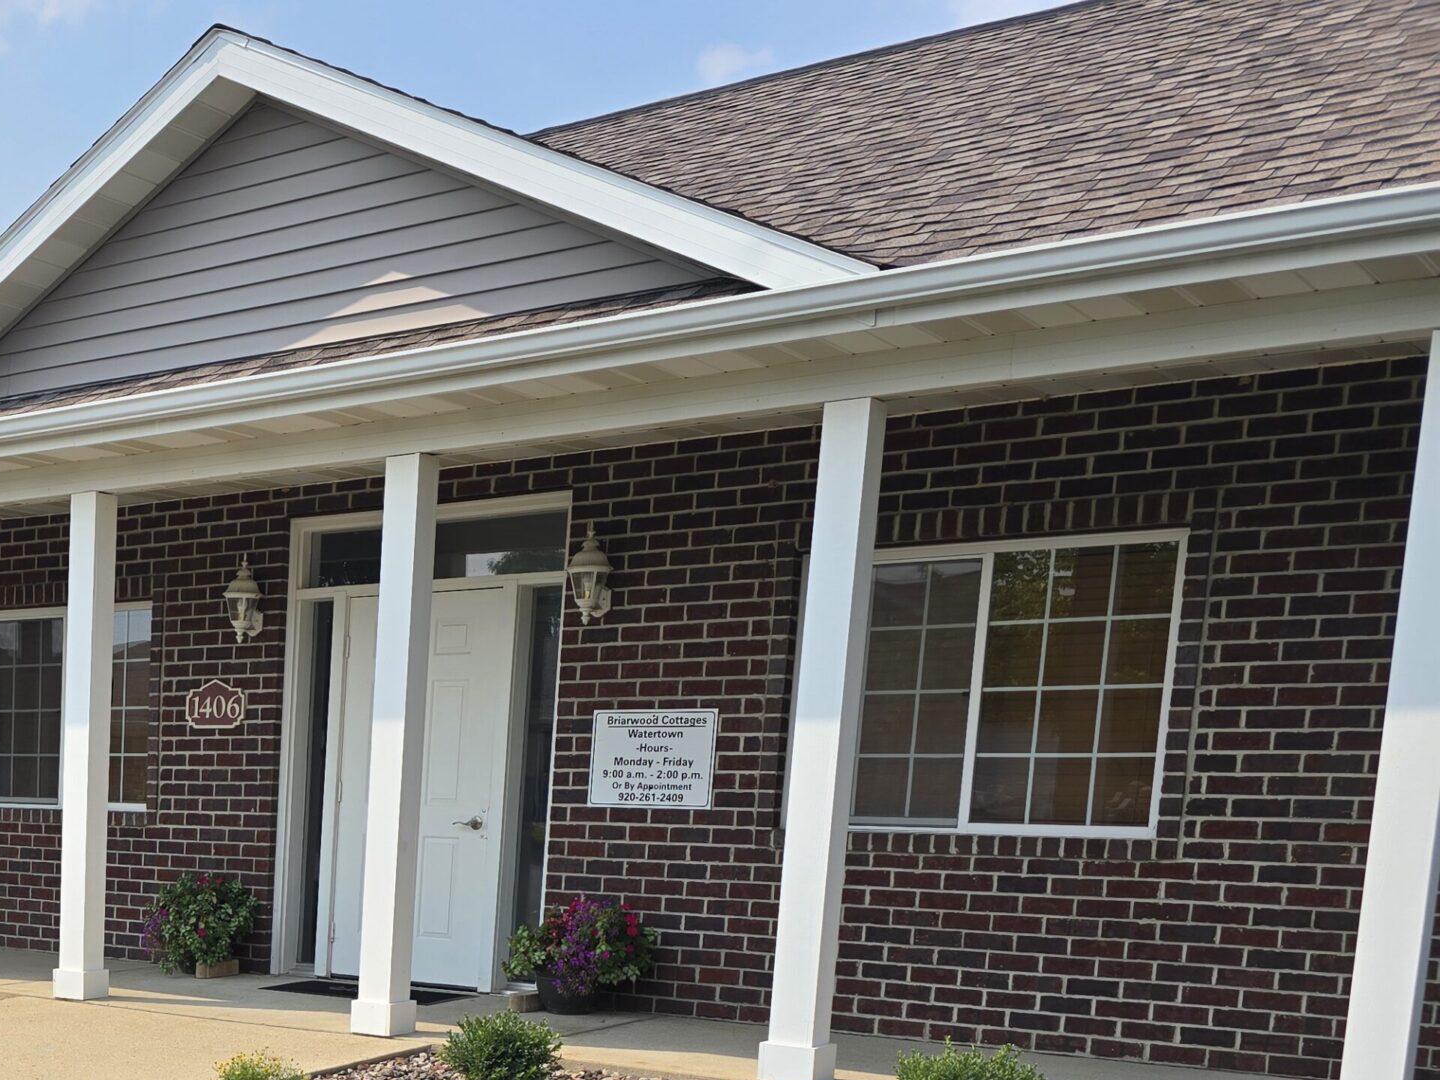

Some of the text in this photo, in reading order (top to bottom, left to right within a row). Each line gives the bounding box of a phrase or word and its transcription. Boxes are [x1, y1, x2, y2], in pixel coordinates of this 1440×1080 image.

[191, 695, 240, 719] 1406
[607, 715, 707, 727] Briarwood Cottages
[628, 729, 683, 739] Watertown
[636, 743, 673, 752] -Hours-
[613, 757, 653, 768] Monday
[662, 757, 694, 768] Friday
[602, 769, 624, 779] 9:00
[626, 771, 648, 779] a.m.
[656, 770, 678, 780] 2:00
[681, 772, 704, 782] p.m.
[612, 782, 692, 791] Or By Appointment
[618, 792, 684, 803] 920-261-2409
